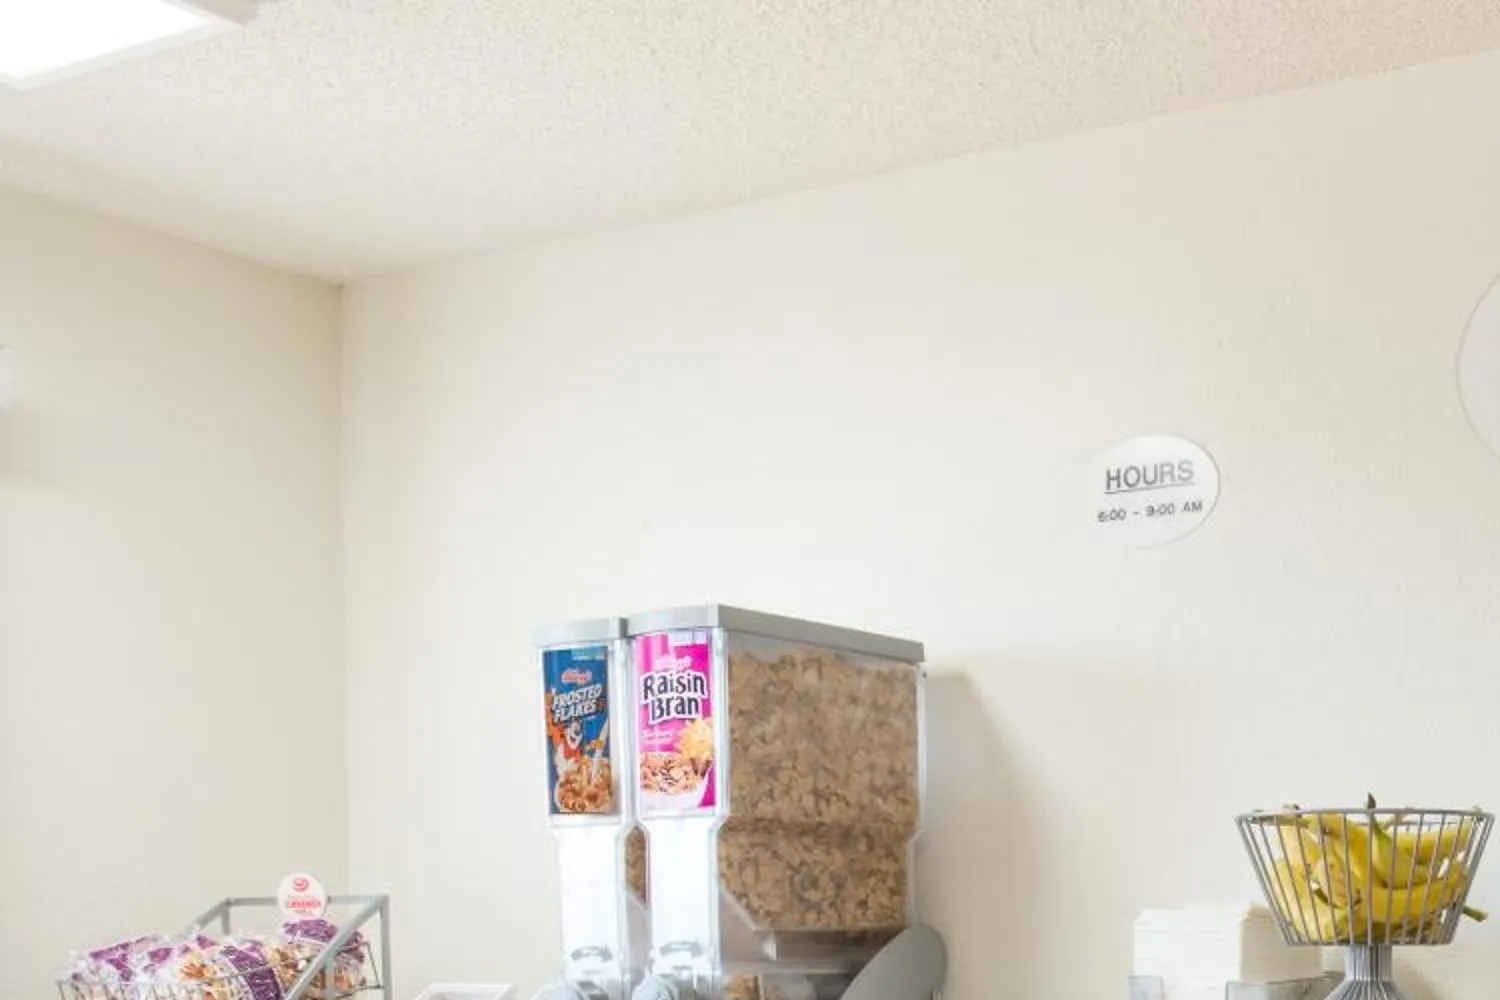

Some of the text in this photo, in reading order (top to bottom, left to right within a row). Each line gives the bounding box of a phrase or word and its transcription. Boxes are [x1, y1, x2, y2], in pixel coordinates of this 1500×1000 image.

[1106, 460, 1195, 491] HOURS
[1182, 499, 1203, 513] AM
[643, 672, 706, 701] Raisin
[651, 695, 700, 721] Bran
